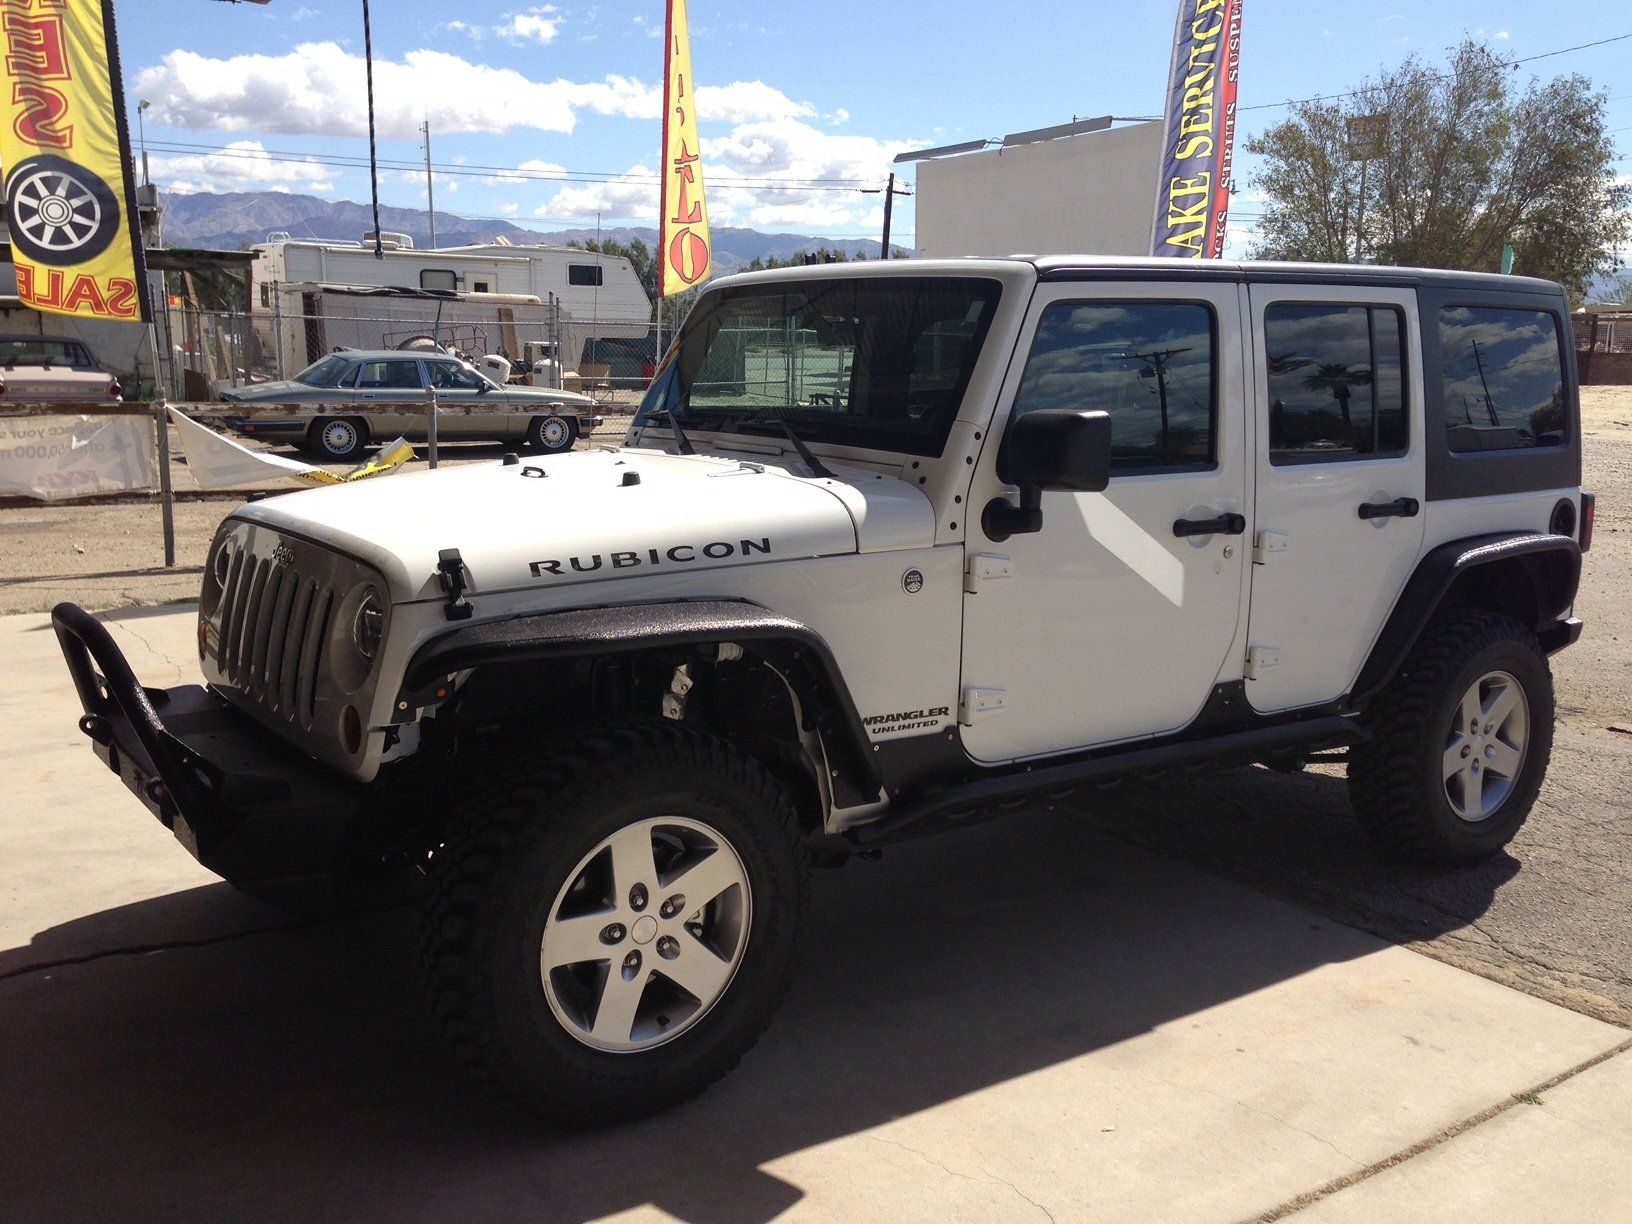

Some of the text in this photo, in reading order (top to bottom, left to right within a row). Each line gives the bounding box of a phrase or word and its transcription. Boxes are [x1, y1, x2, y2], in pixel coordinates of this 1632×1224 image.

[1220, 102, 1236, 189] STRUTS
[1165, 171, 1211, 259] AKE
[271, 541, 295, 563] Jeep
[528, 537, 772, 578] RUBICON
[862, 706, 950, 727] WRANGLER
[872, 719, 939, 735] UNLIMITED
